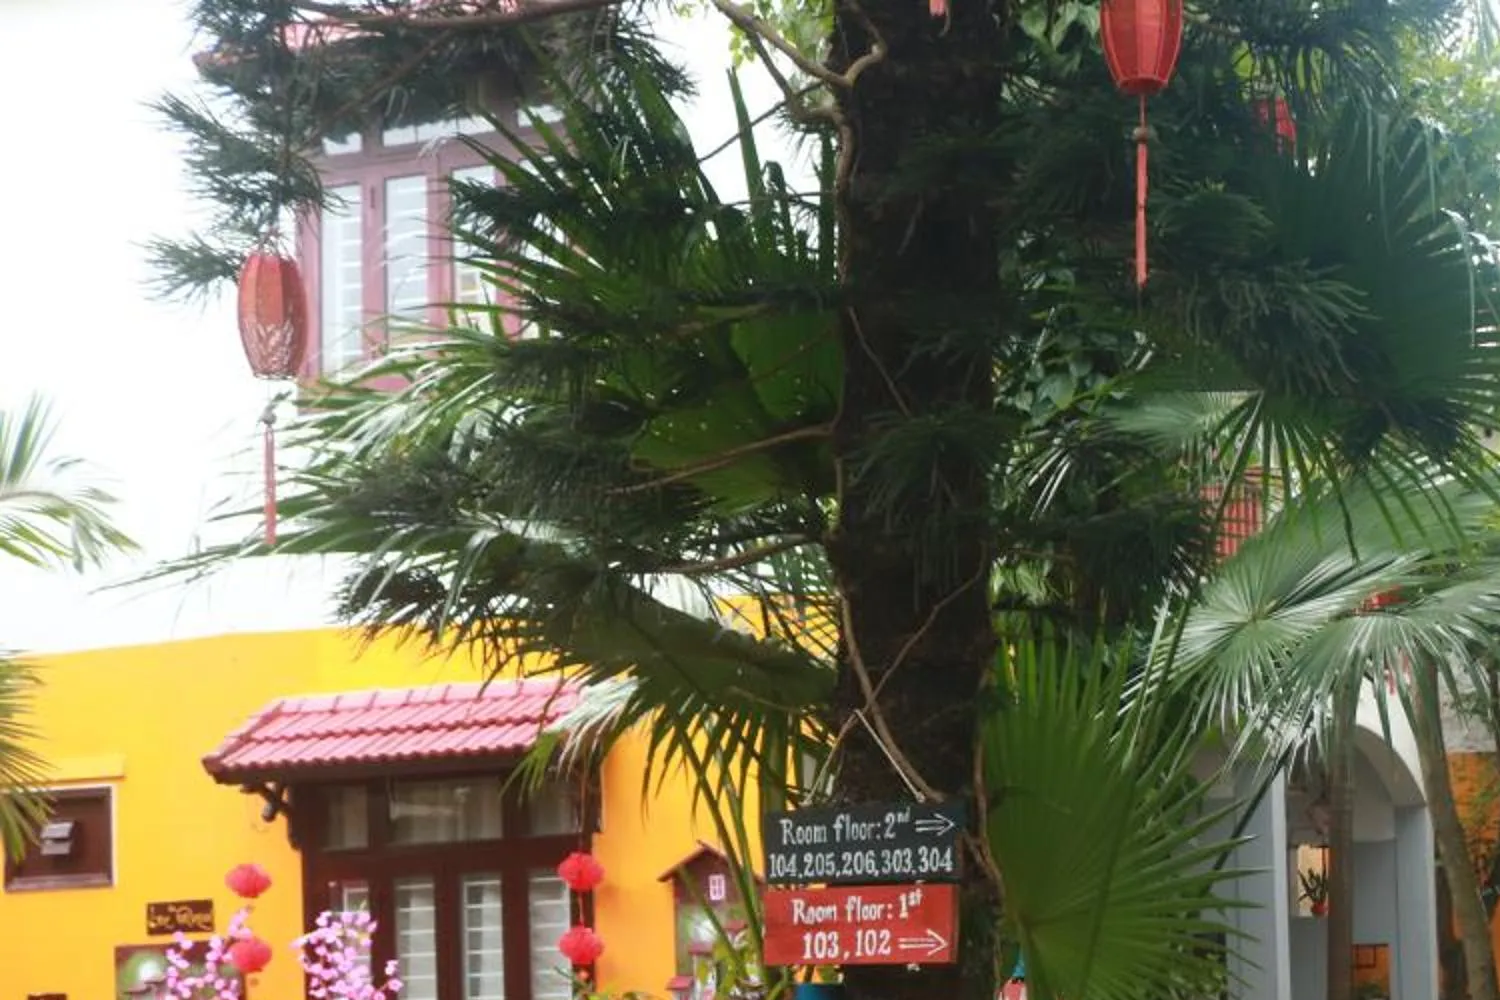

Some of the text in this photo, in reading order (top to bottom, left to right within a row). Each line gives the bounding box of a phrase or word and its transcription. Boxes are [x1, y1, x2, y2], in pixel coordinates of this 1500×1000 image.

[779, 806, 911, 846] Room floor: 2nd
[791, 888, 923, 925] Room floor: 1st
